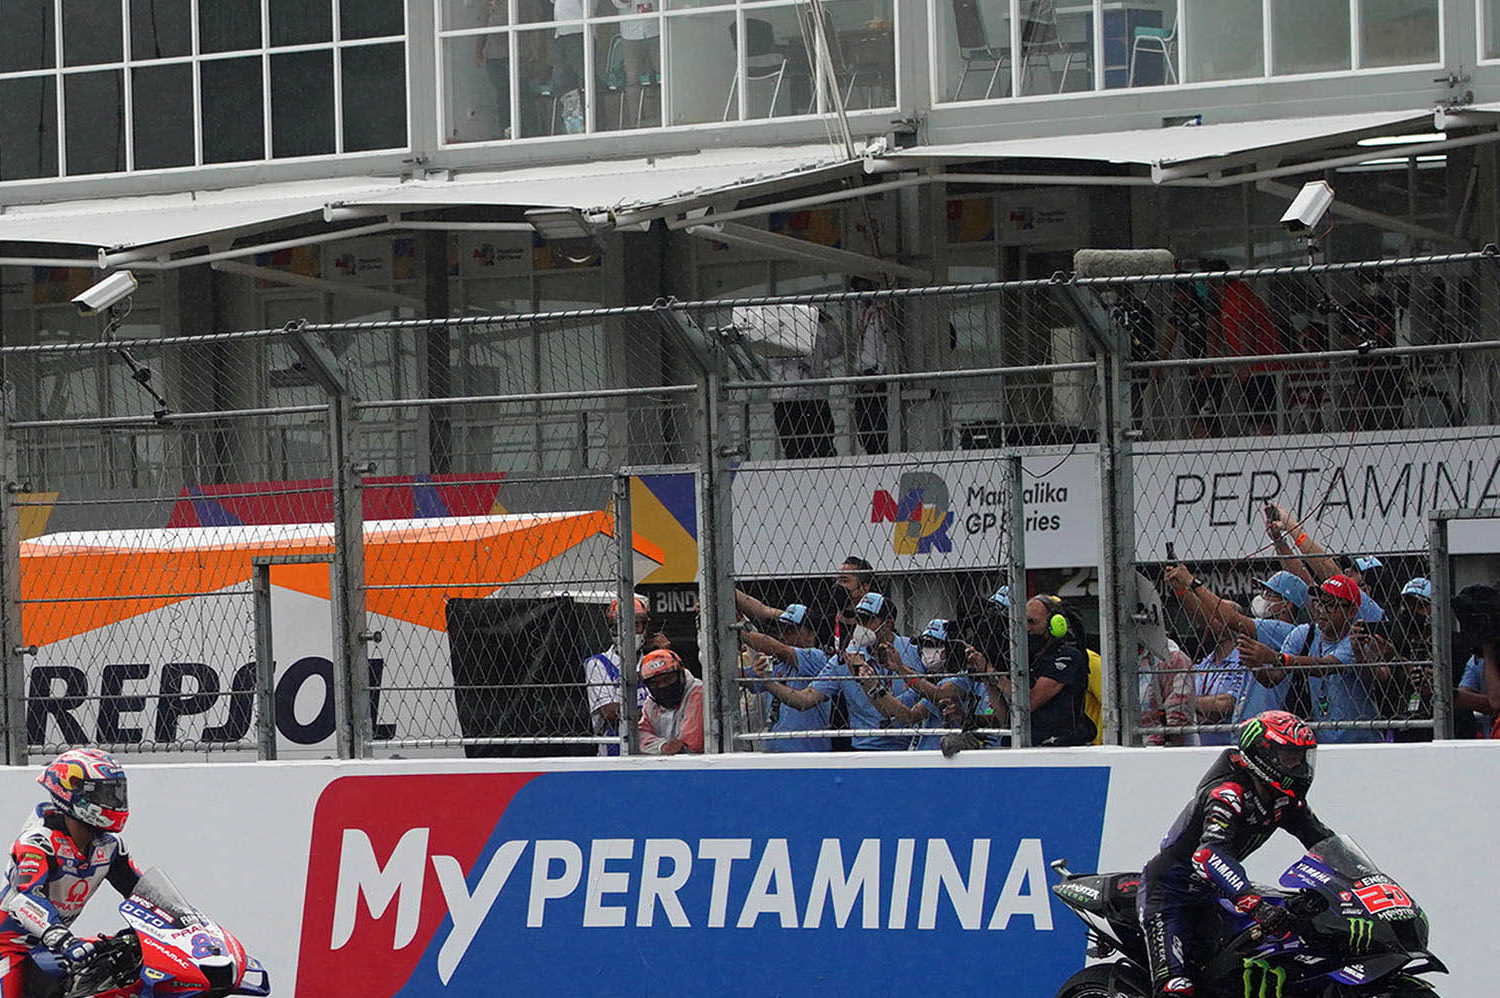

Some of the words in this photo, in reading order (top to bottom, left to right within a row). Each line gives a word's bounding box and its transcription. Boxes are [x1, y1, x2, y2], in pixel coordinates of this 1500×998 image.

[966, 481, 1068, 508] Manalika
[966, 514, 997, 535] GP
[26, 656, 396, 745] REPSOL
[1207, 853, 1245, 892] YAMAHA
[1296, 863, 1331, 884] YAMAHA
